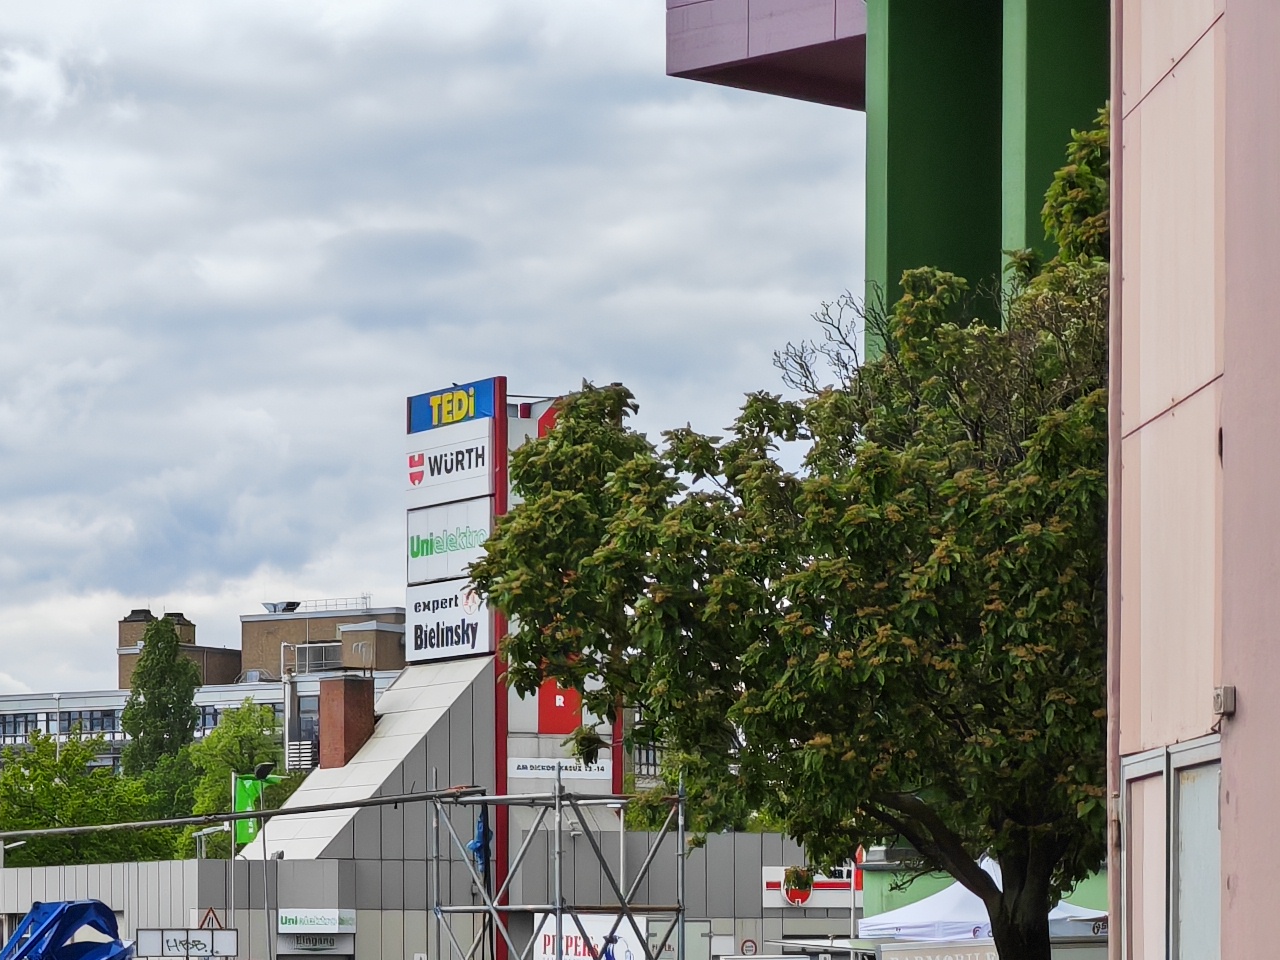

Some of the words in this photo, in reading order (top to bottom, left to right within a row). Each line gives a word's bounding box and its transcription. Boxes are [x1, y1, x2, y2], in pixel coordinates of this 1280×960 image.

[429, 386, 476, 426] TEDi
[427, 445, 486, 477] WÜRTH
[409, 525, 488, 559] Unielektro
[413, 594, 459, 614] expert
[413, 618, 479, 651] Bielinsky
[295, 934, 335, 947] Eingang
